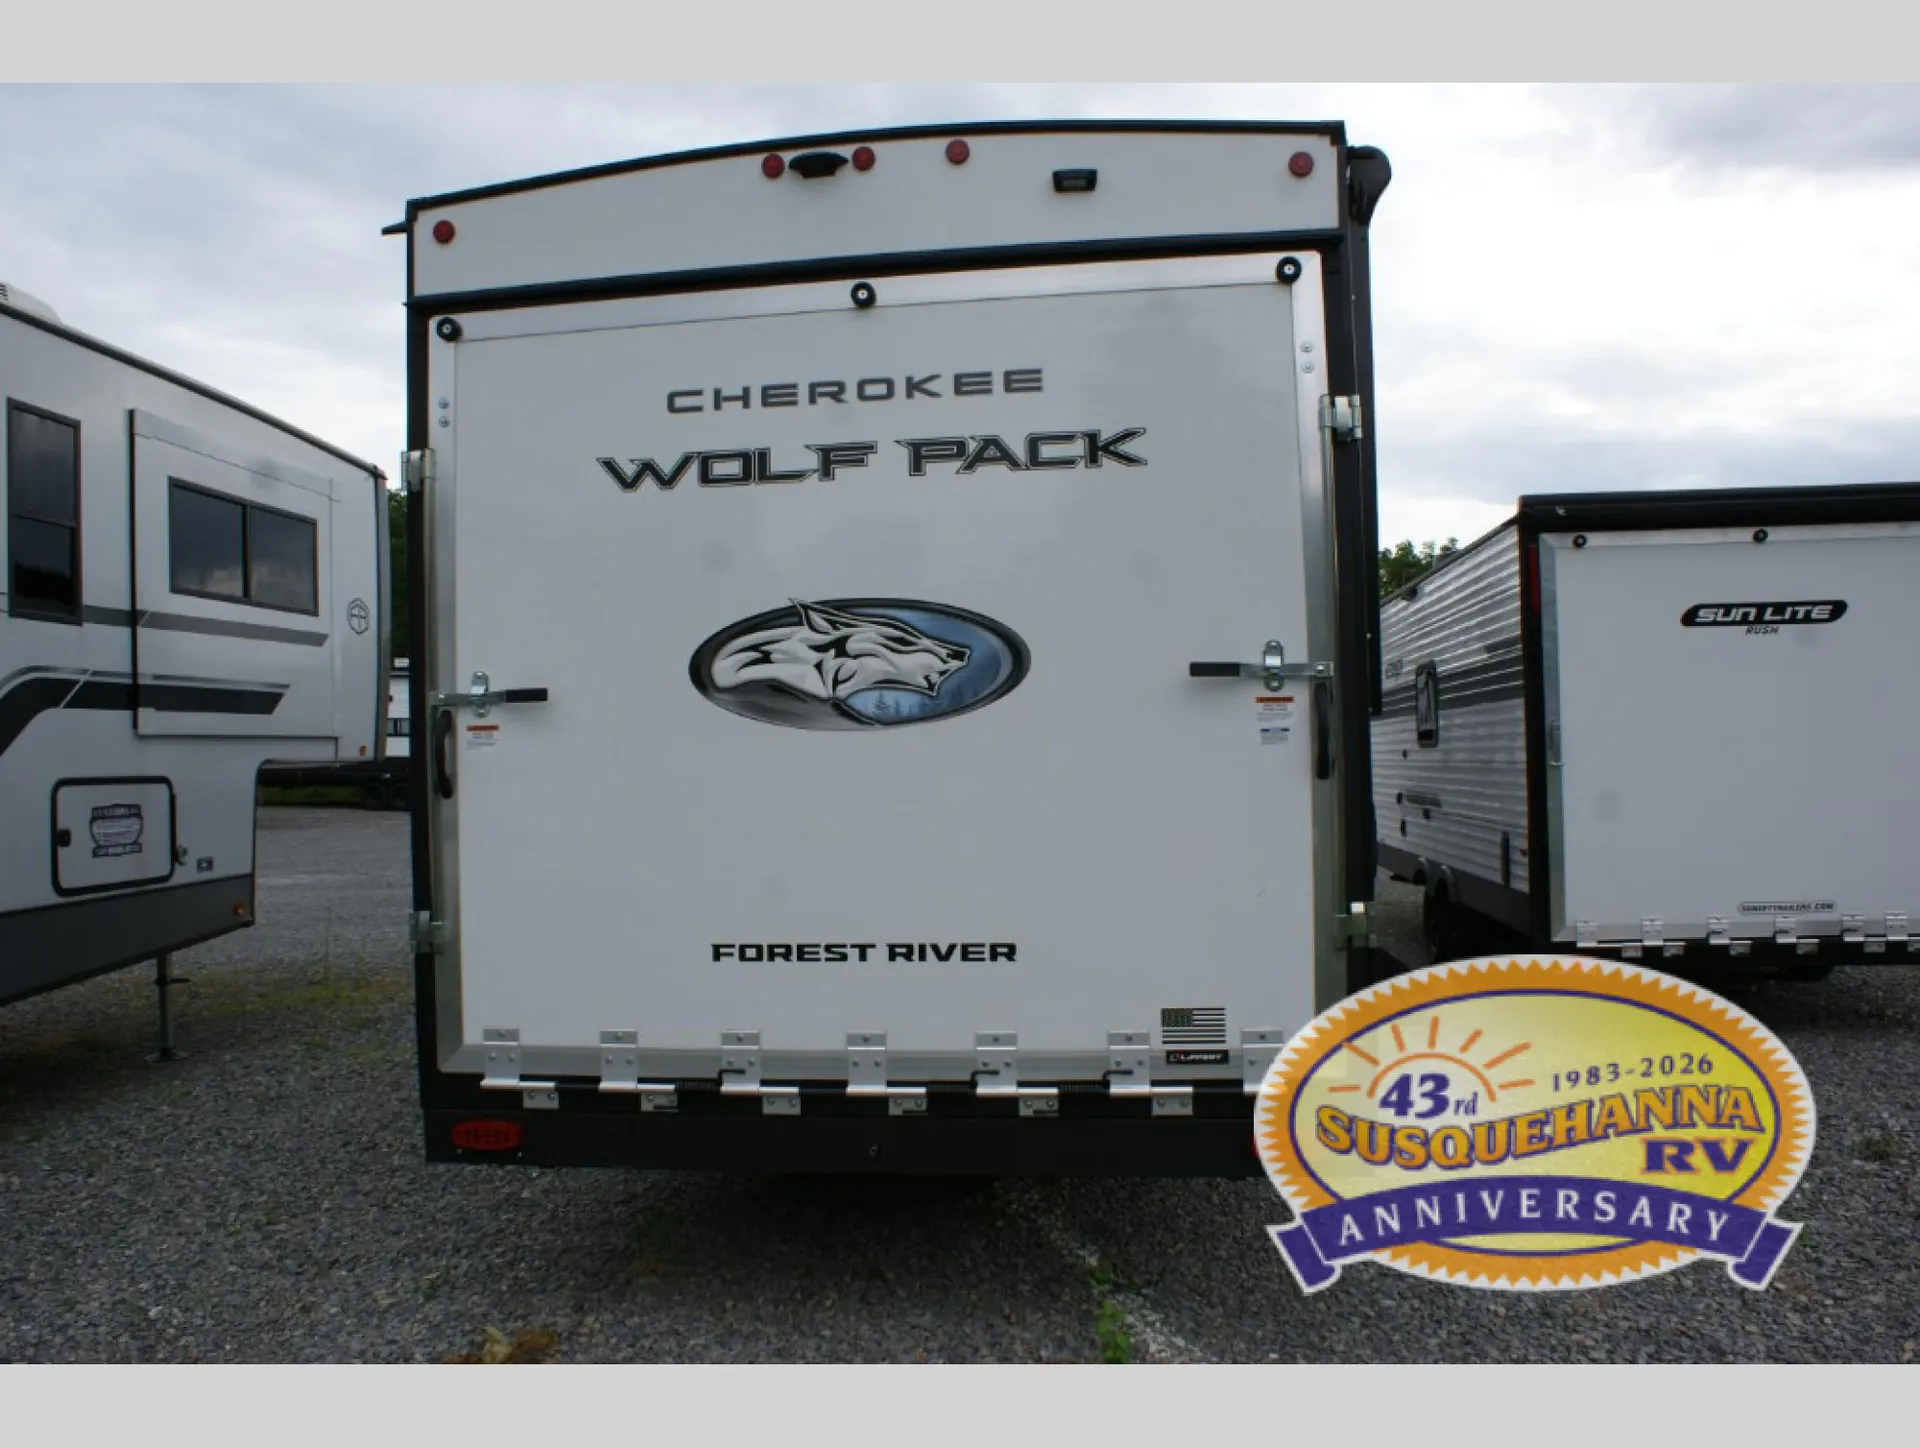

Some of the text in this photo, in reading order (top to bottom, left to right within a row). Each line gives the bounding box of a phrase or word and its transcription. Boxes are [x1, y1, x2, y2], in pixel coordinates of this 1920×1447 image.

[665, 367, 1045, 414] CHEROKEE
[596, 427, 1148, 493] WOLF PACK
[1695, 604, 1834, 623] SUN LITE
[1745, 625, 1780, 636] RUSH
[711, 942, 1017, 962] FOREST RIVER
